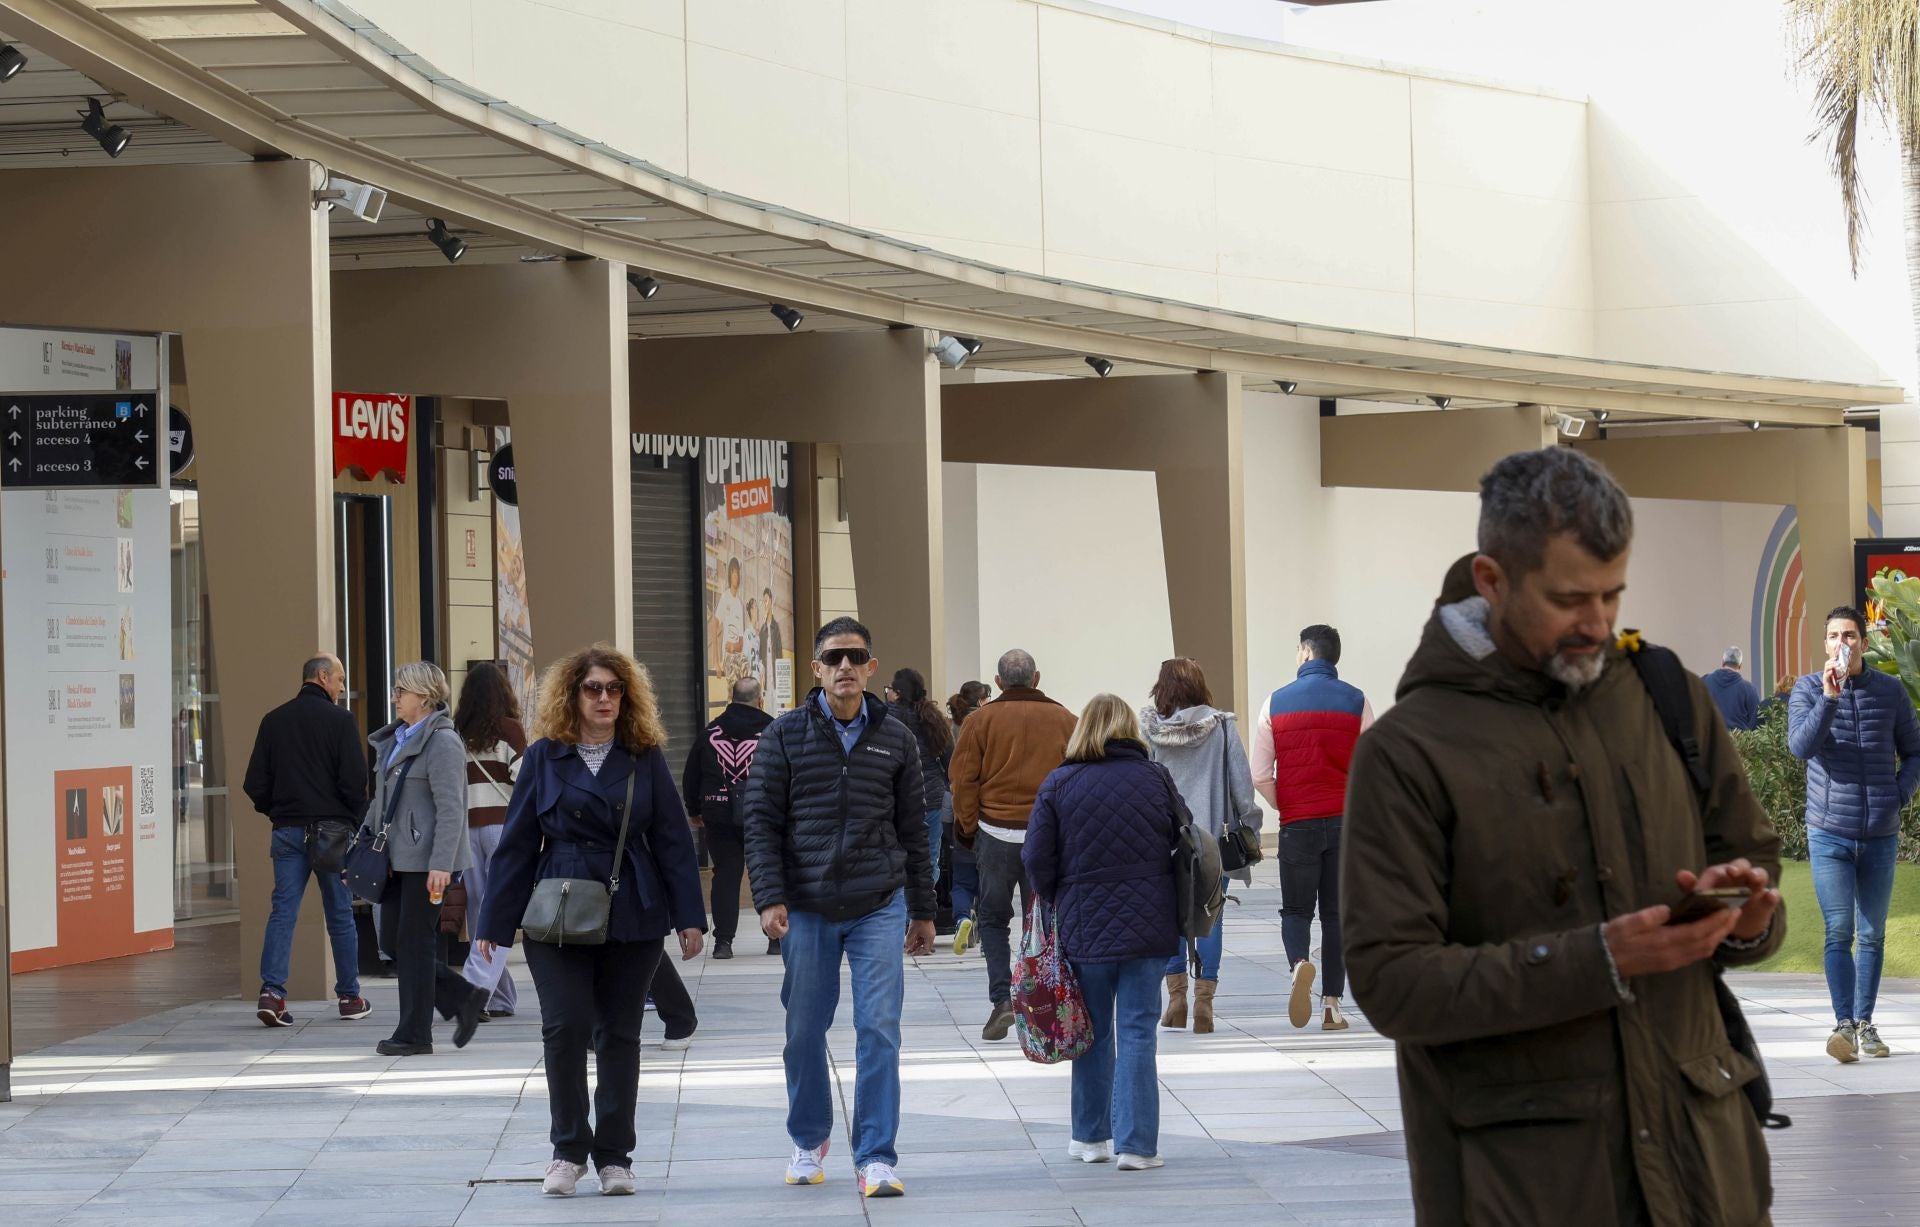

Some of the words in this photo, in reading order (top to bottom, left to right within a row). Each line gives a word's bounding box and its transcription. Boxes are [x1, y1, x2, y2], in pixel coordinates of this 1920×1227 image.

[36, 405, 87, 421] parking
[36, 416, 117, 430] subterráneo
[36, 437, 80, 446] acceso
[83, 433, 91, 445] 4
[36, 463, 80, 472] acceso
[83, 459, 92, 472] 3
[706, 436, 789, 489] OPENING
[731, 486, 769, 510] SOON
